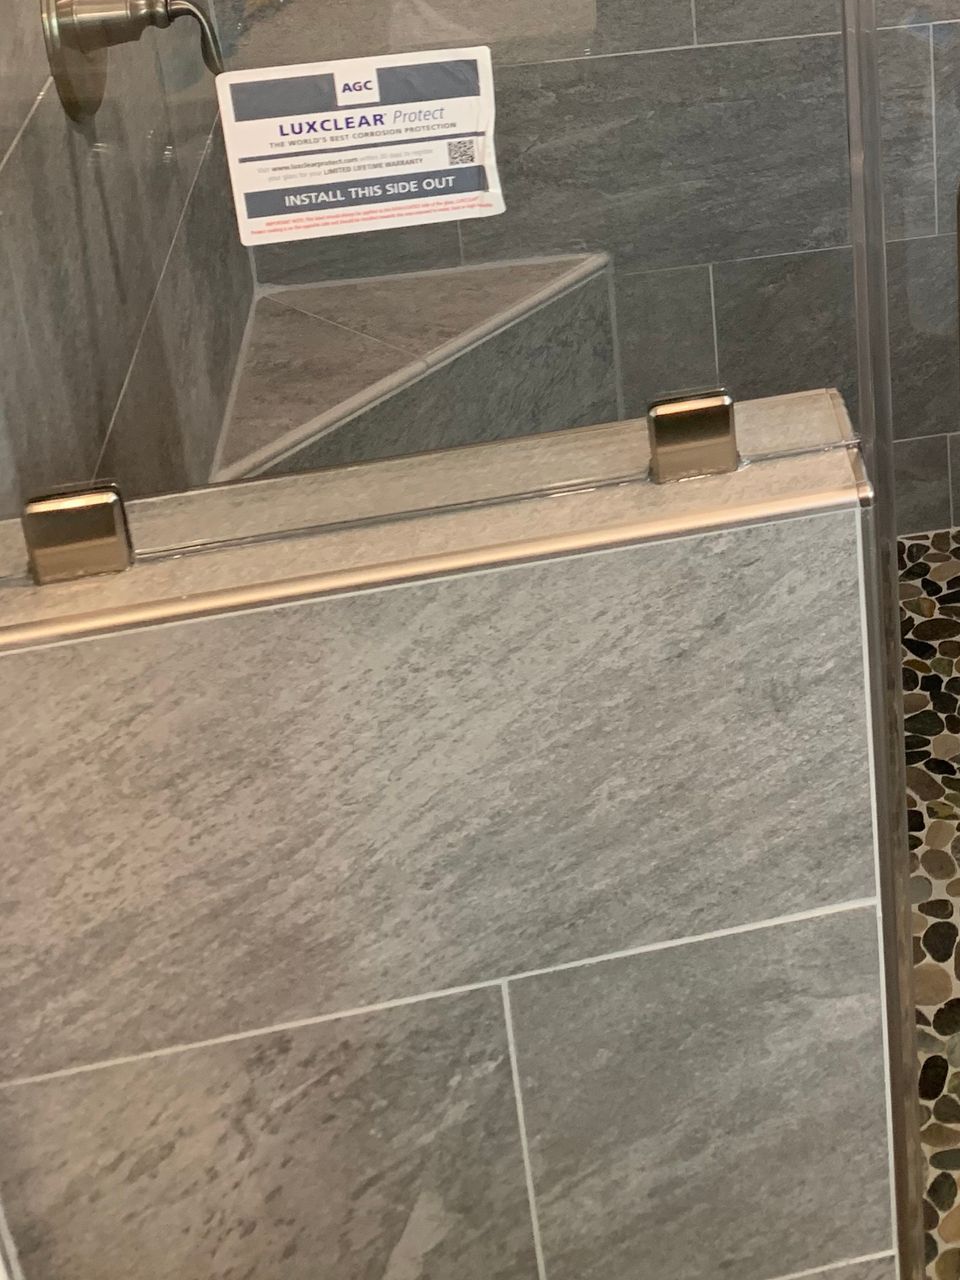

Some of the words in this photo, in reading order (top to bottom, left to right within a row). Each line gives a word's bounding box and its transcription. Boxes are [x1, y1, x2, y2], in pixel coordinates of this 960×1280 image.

[341, 80, 374, 93] AGC
[269, 141, 285, 149] THE
[288, 136, 328, 148] WORLD'S
[329, 134, 349, 142] BEST
[352, 128, 403, 140] CORROSION
[404, 122, 457, 133] PROTECTION
[279, 113, 385, 137] LUXCLEAR
[393, 107, 445, 124] Protect
[323, 166, 351, 176] LIMITED
[353, 162, 383, 172] LIFETIME
[385, 158, 424, 168] WARRANTY
[284, 189, 346, 207] INSTALL
[348, 184, 382, 200] THIS
[386, 180, 419, 195] SIDE
[422, 175, 456, 190] OUT
